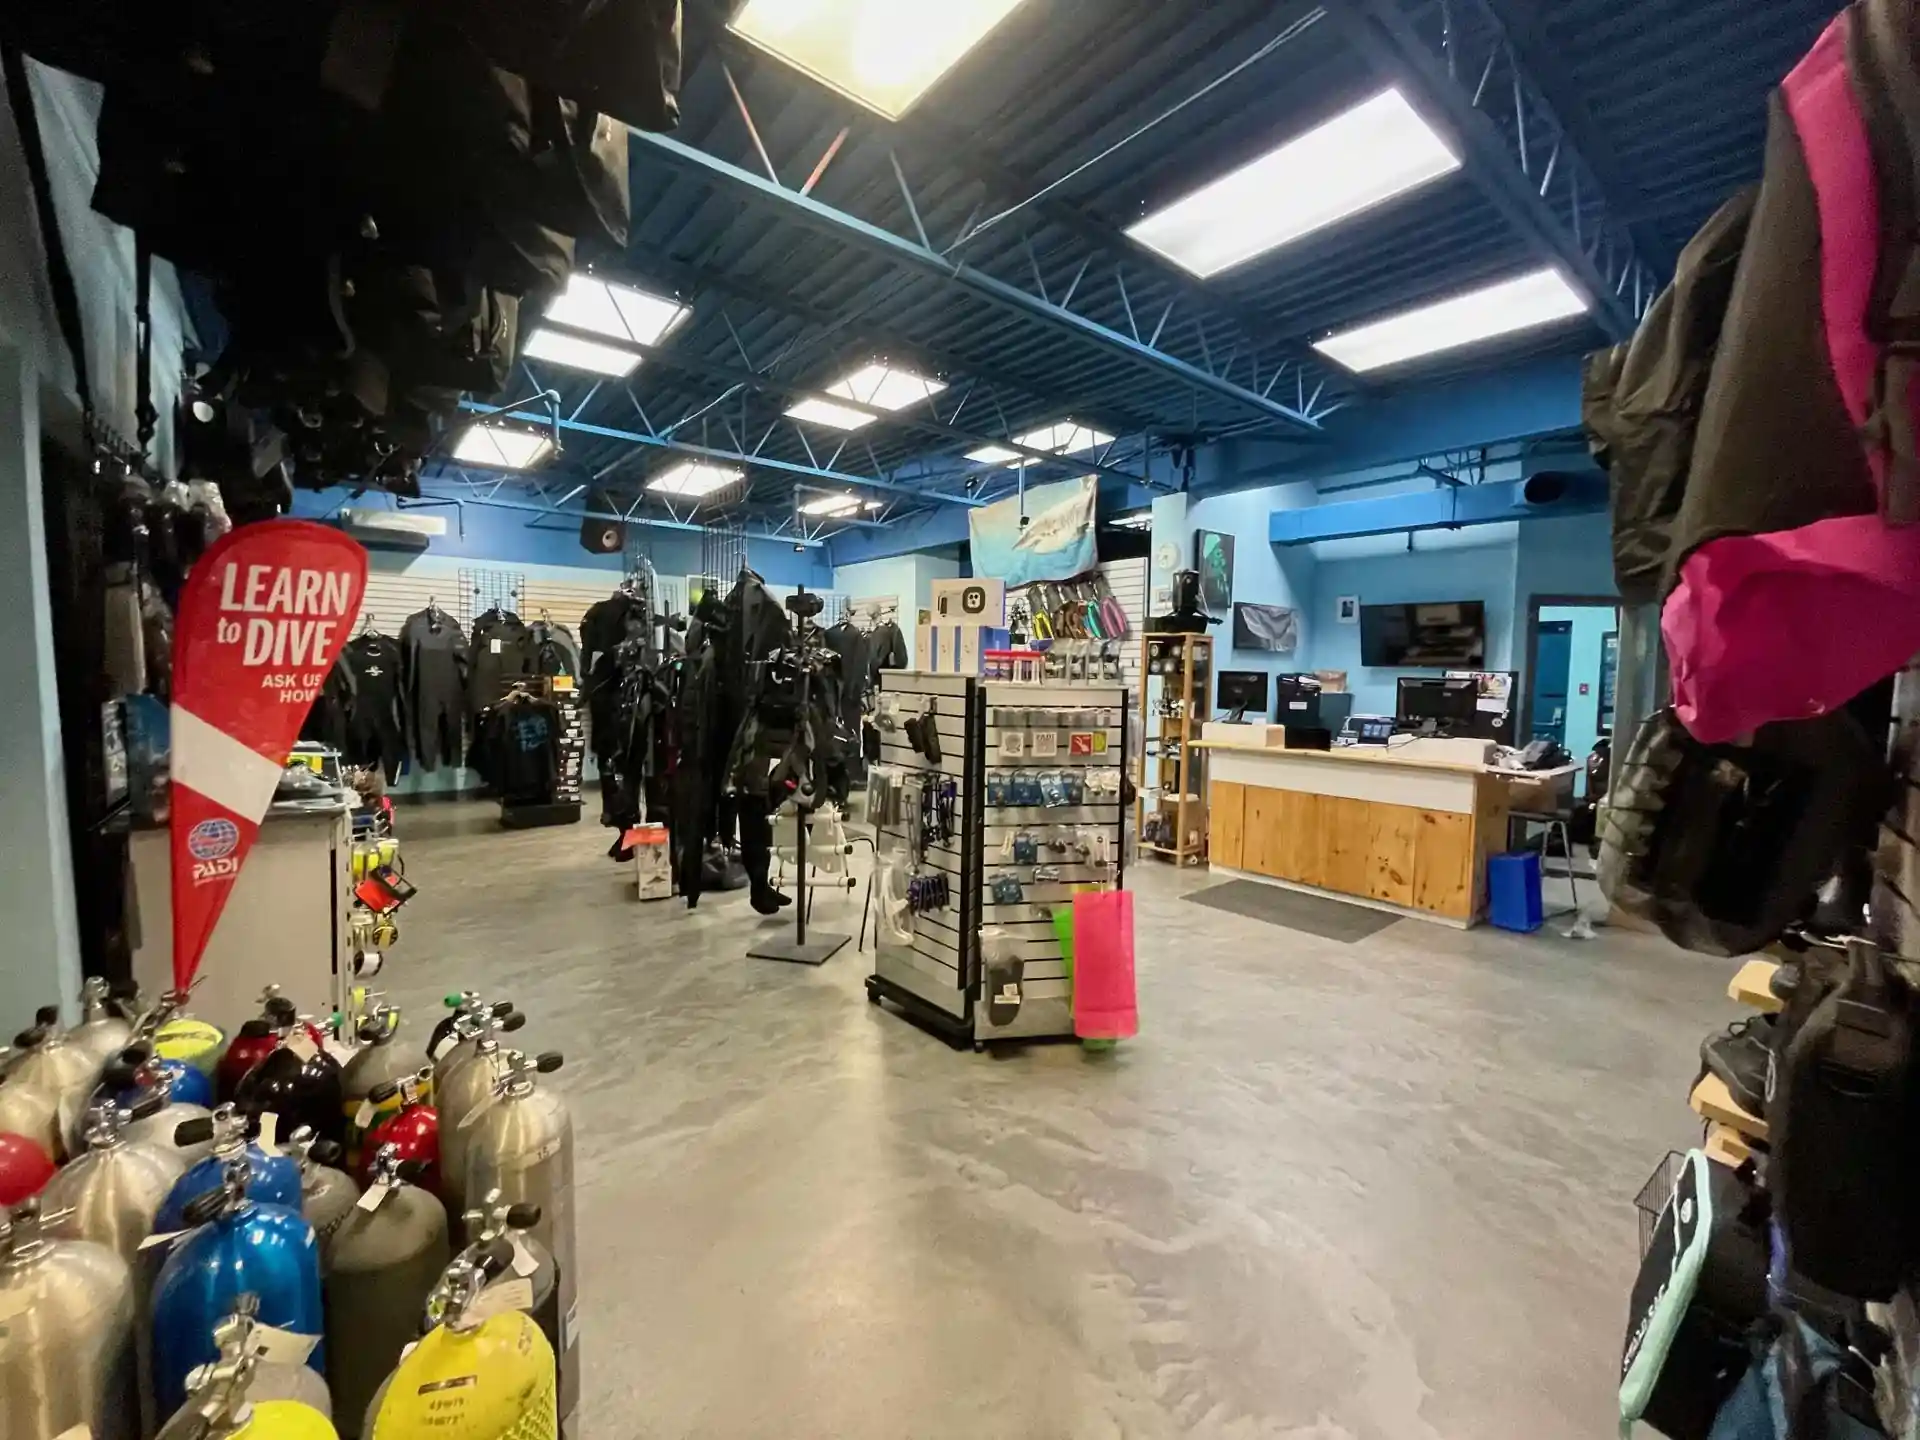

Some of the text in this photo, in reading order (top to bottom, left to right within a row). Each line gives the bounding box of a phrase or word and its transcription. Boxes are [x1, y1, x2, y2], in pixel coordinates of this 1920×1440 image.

[220, 562, 351, 616] LEARN
[217, 616, 337, 667] to DIVE
[261, 672, 322, 688] ASK US
[192, 857, 239, 880] PADI
